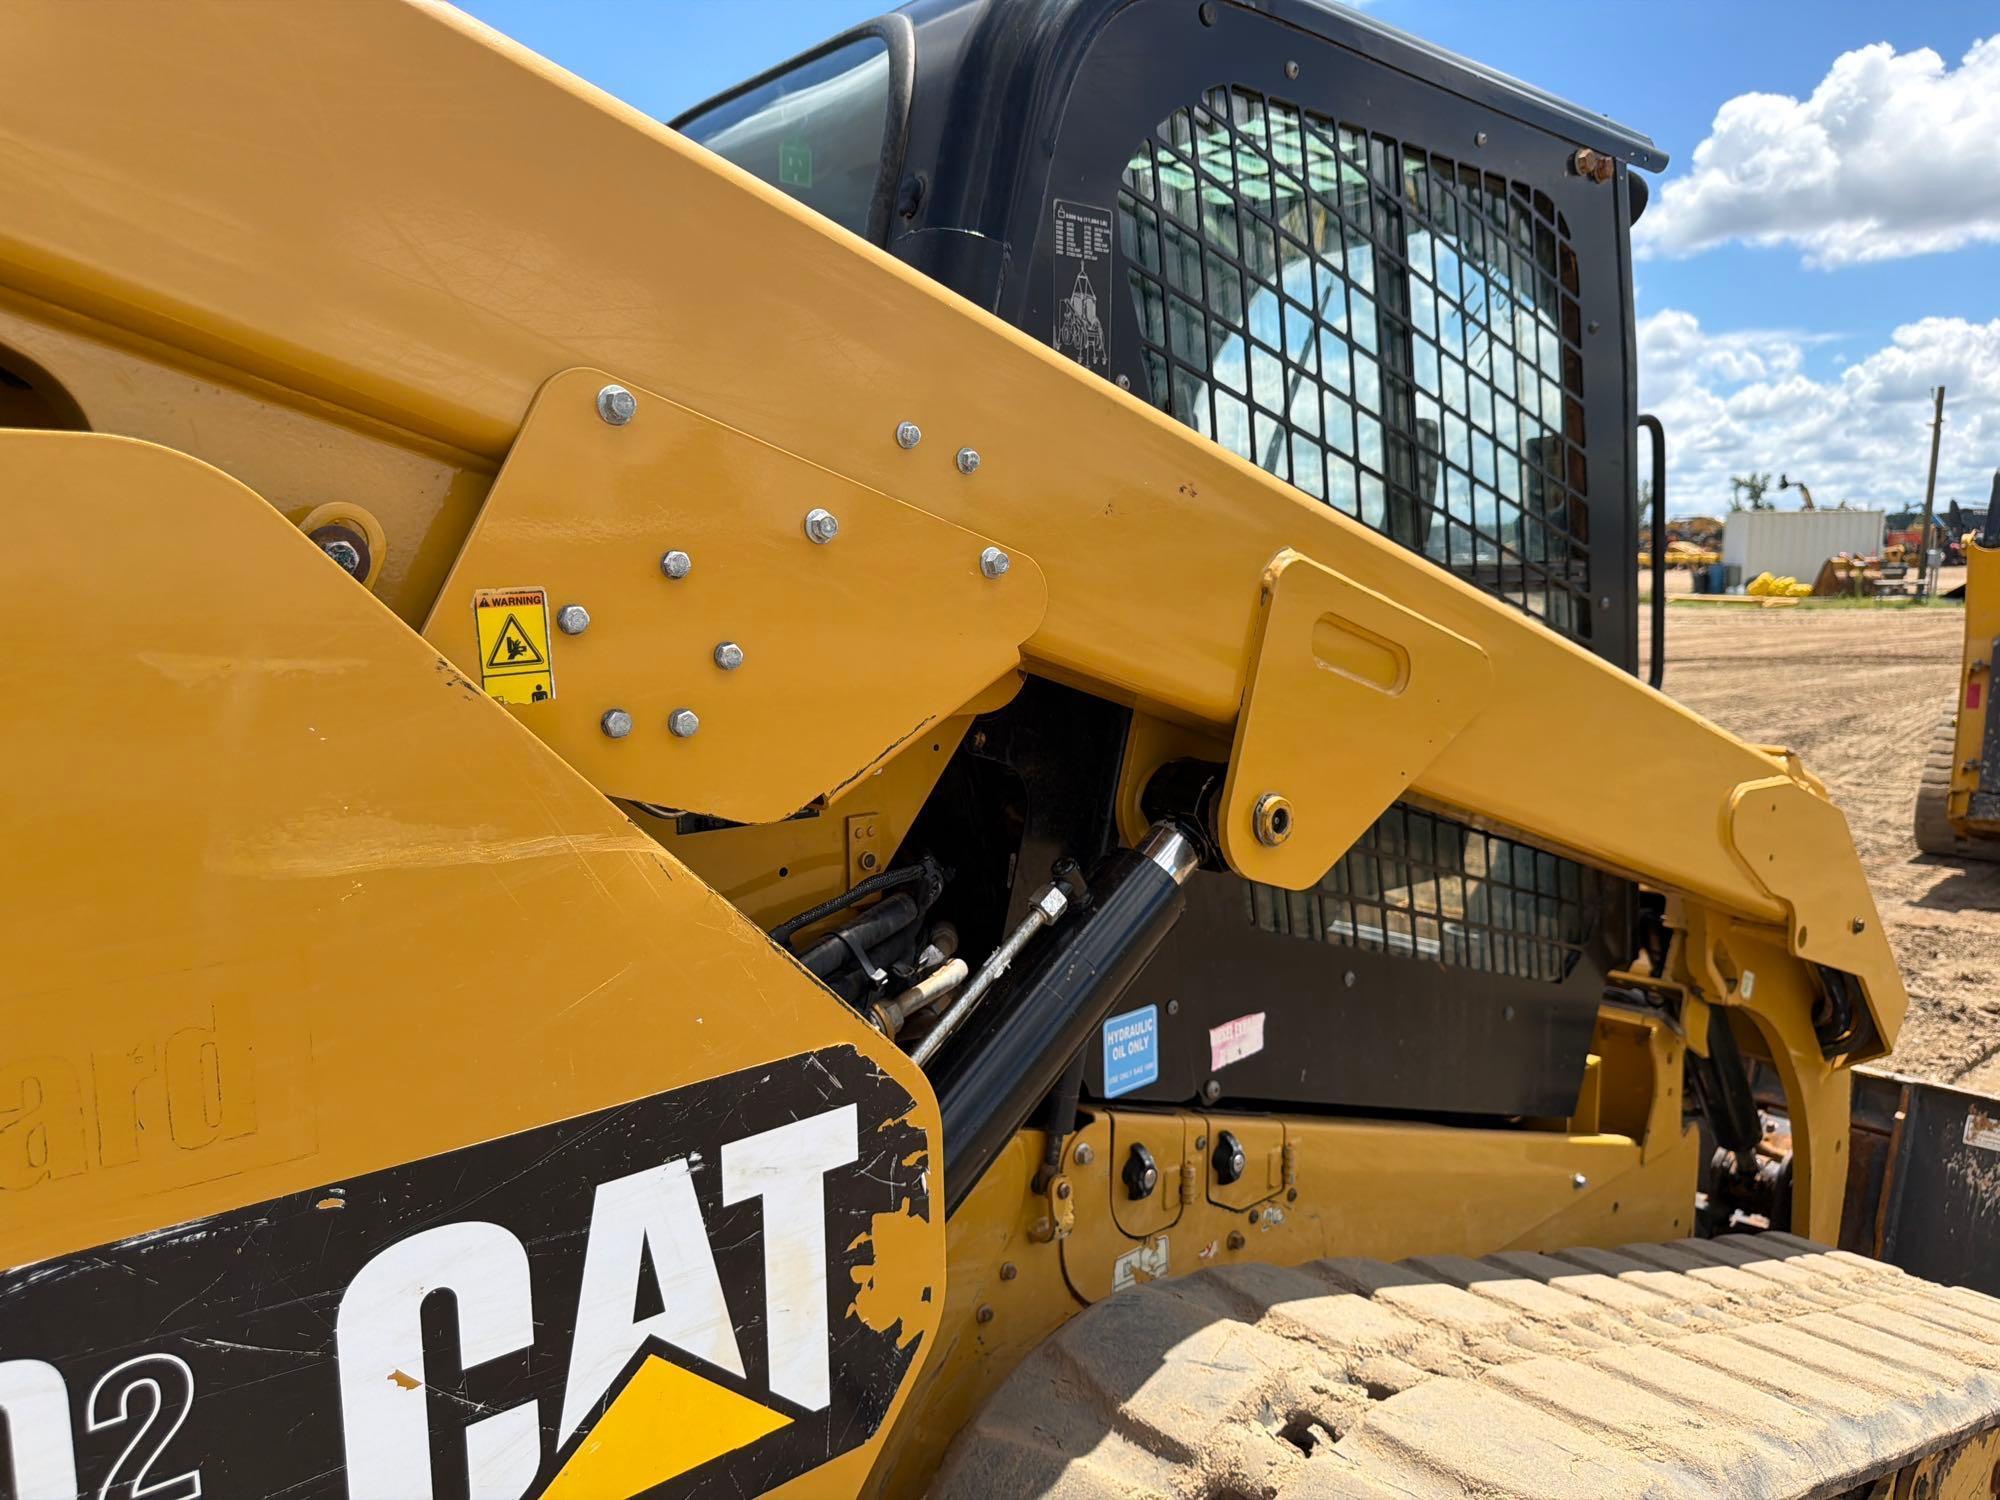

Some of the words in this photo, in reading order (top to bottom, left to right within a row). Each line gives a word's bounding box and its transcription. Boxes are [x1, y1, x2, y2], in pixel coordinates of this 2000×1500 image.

[492, 596, 541, 607] WARNING
[1107, 1018, 1153, 1045] HYDRAULIC
[1112, 1045, 1126, 1060] OIL
[1128, 1035, 1149, 1055] ONLY
[336, 1102, 858, 1500] CAT
